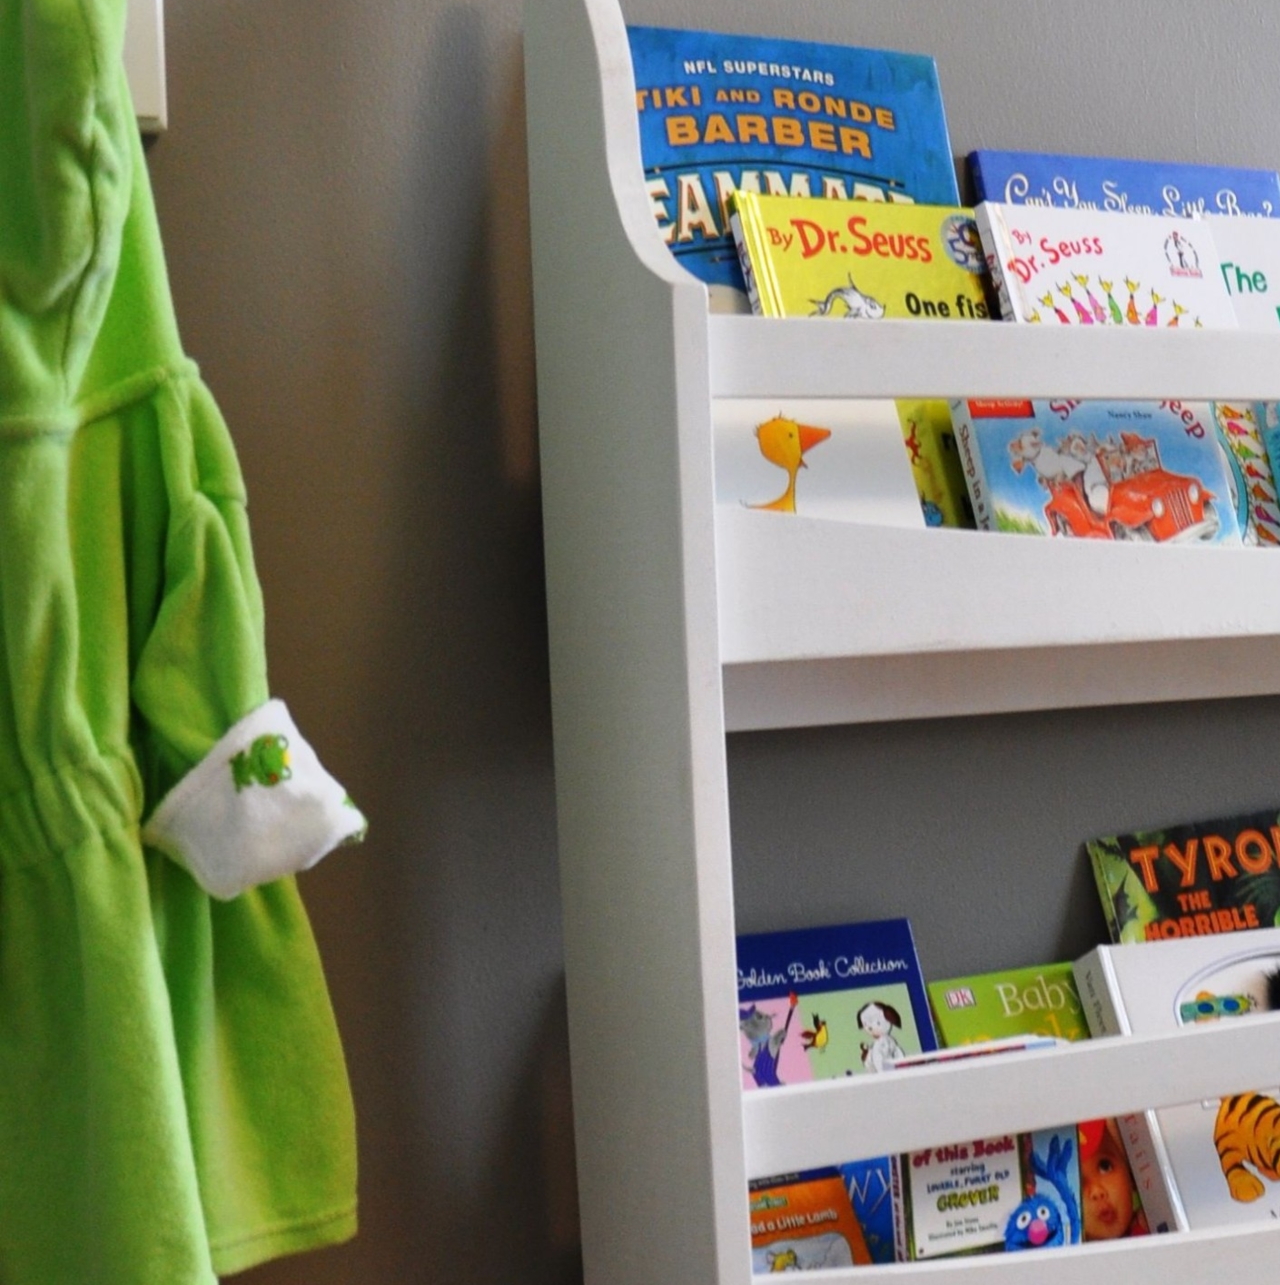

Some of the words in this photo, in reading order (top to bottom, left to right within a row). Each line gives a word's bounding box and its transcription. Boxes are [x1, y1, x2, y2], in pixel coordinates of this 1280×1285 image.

[684, 60, 717, 75] NFL
[723, 60, 835, 86] SUPERSTARS
[636, 86, 701, 111] TIKI
[716, 89, 761, 103] AND
[773, 88, 895, 130] RONDE
[666, 114, 872, 159] BARBER
[766, 226, 794, 251] By
[790, 218, 847, 259] Dr.
[847, 216, 932, 263] Seuss
[1011, 229, 1032, 246] By
[1007, 255, 1045, 284] Dr.
[1040, 236, 1103, 265] Seuss
[905, 292, 951, 318] One
[958, 424, 976, 479] Sheep
[971, 479, 982, 498] in
[1177, 889, 1212, 912] THE
[1143, 902, 1260, 941] HORRIBLE
[787, 960, 831, 984] Book
[834, 955, 908, 978] Collection
[948, 987, 975, 1008] DK
[912, 1148, 932, 1168] of
[935, 1143, 968, 1164] this
[972, 1135, 1015, 1158] Book
[936, 1184, 1000, 1213] GROVER
[766, 1223, 776, 1233] a
[776, 1214, 806, 1230] Little
[807, 1208, 838, 1223] Lamb
